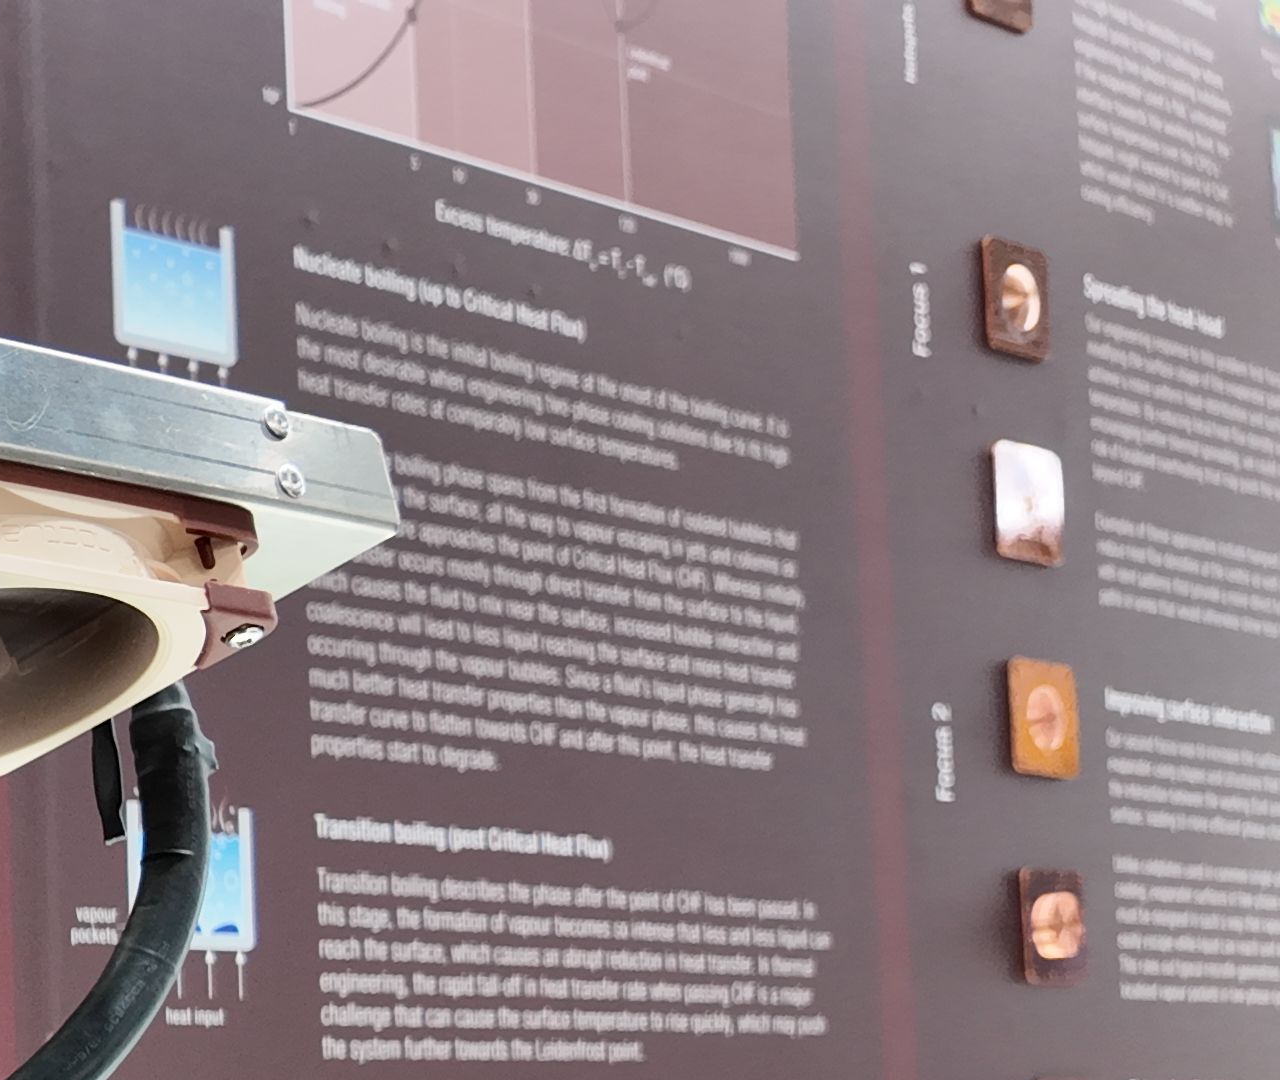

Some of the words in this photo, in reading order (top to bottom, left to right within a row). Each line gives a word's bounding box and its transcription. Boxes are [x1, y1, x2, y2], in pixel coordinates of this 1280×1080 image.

[316, 811, 391, 843] Transition
[393, 817, 446, 851] boiling
[447, 822, 486, 854] (post
[487, 825, 538, 853] Critical
[540, 829, 573, 856] Heat
[575, 832, 610, 862] Flux)
[75, 906, 118, 926] vapour
[165, 1006, 191, 1026] heat
[194, 1006, 225, 1028] input
